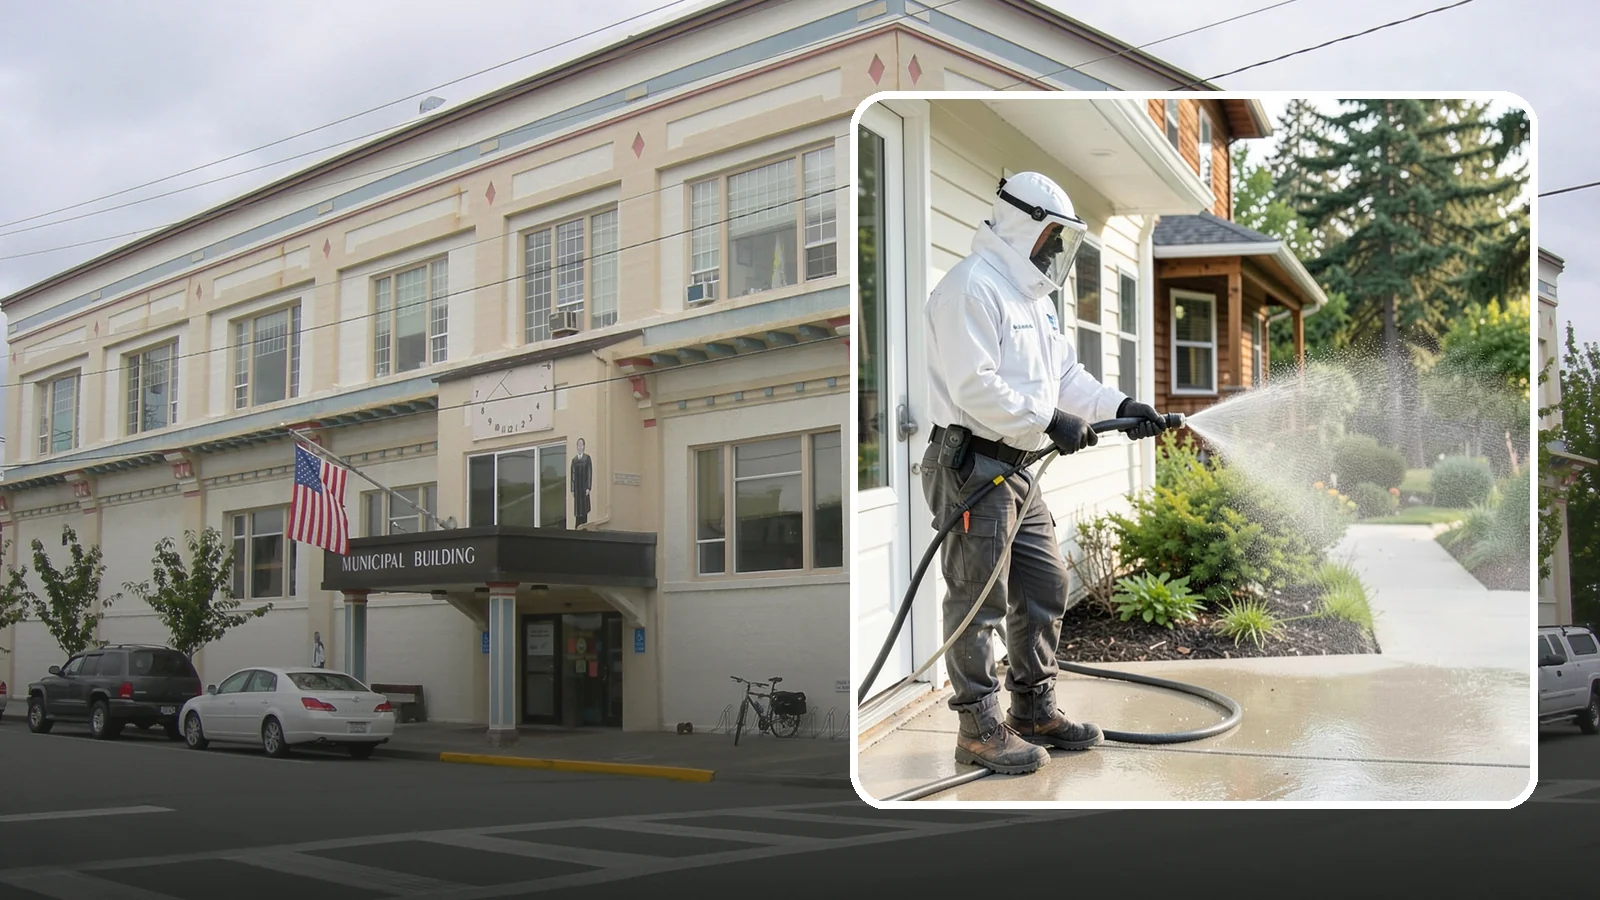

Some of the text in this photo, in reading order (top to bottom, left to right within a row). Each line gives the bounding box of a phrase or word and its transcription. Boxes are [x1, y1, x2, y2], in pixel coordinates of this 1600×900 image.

[536, 402, 540, 410] 4
[481, 407, 485, 415] 8
[521, 420, 525, 428] 2
[342, 546, 475, 572] MUNICIPAL BUILDING
